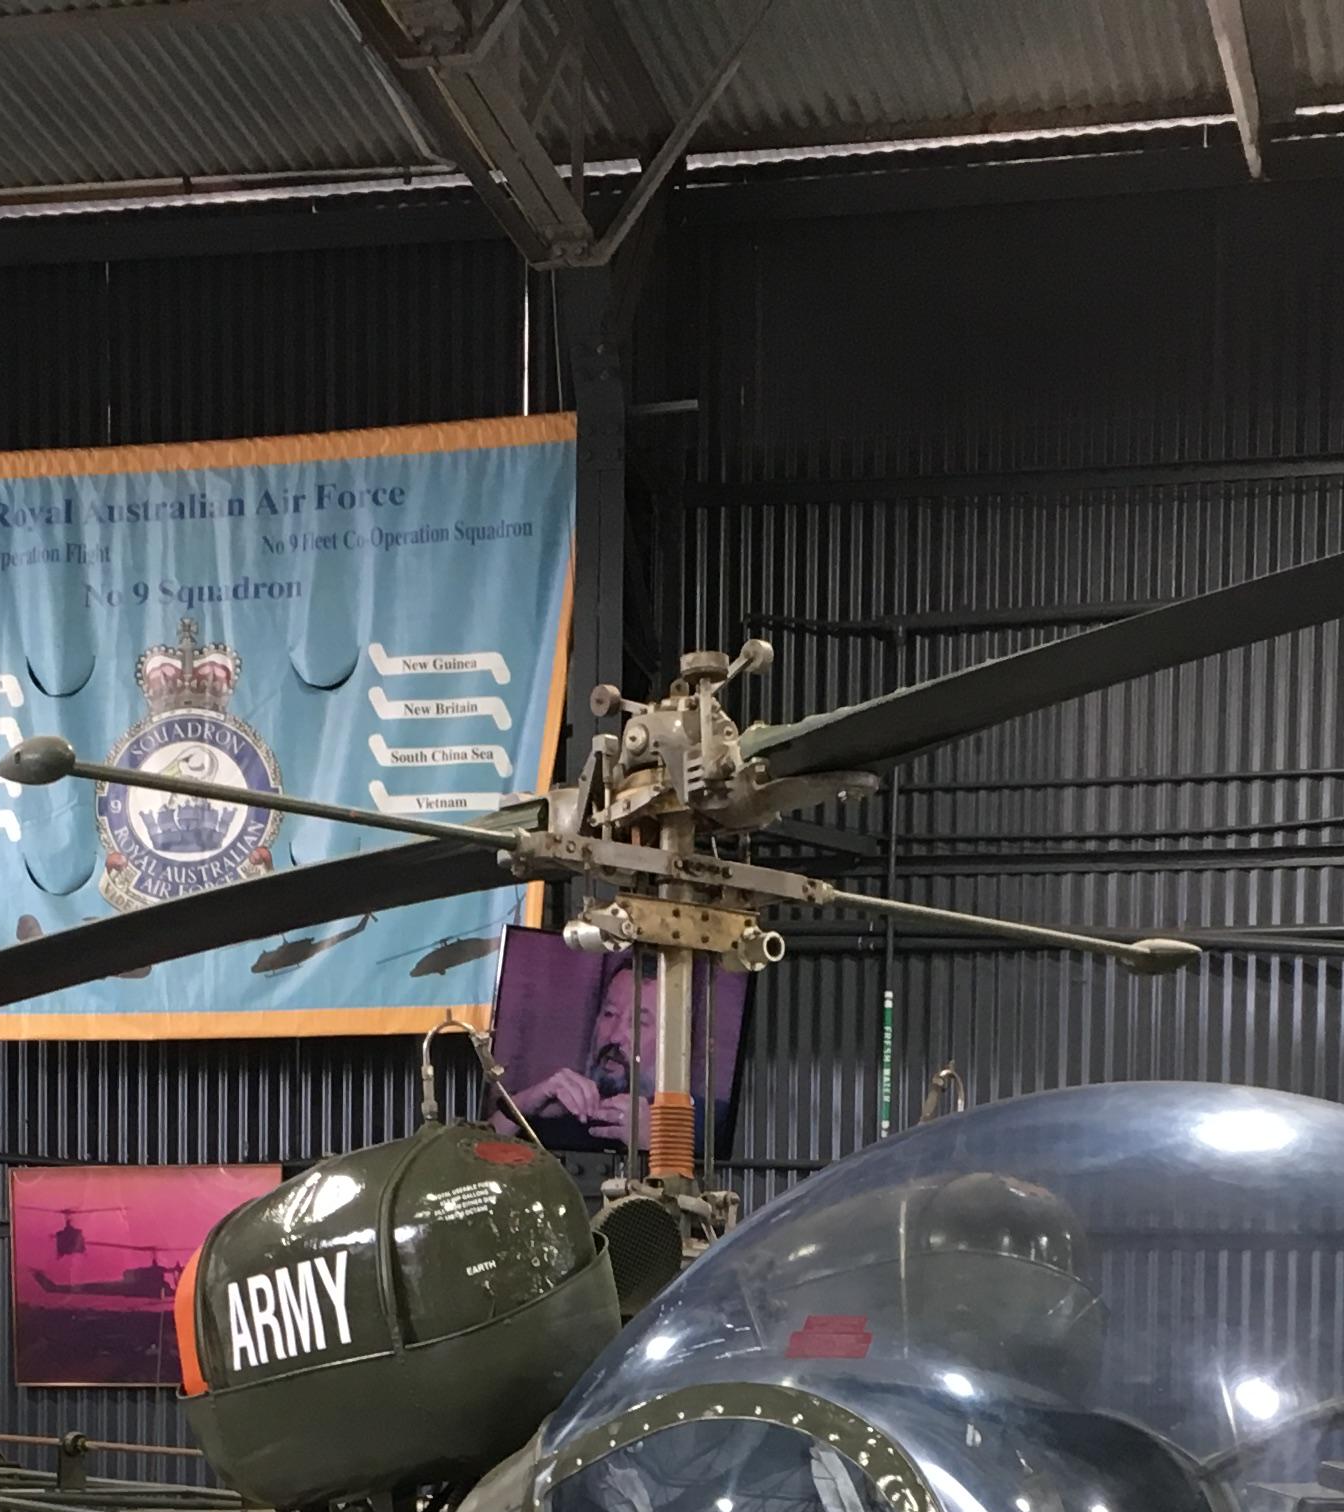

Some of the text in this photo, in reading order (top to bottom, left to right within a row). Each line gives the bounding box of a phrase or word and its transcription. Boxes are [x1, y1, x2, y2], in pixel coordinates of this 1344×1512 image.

[84, 493, 245, 525] Australian
[255, 488, 306, 516] Air
[315, 483, 405, 510] Force
[262, 517, 533, 556] No 9 Fleet Co-Operation Squadron
[65, 540, 111, 567] Flight
[83, 575, 303, 610] No 9 Squadron
[402, 657, 477, 672] New Guinea
[404, 701, 478, 716] New Britain
[129, 721, 246, 757] SQUADRON
[390, 747, 494, 764] South China Sea
[109, 799, 122, 814] 9
[416, 796, 467, 810] Vietnam
[114, 819, 265, 884] ROYAL AUSTRALIAN
[140, 876, 172, 899] AIR
[466, 1259, 497, 1276] EARTH
[228, 1250, 352, 1371] ARMY
